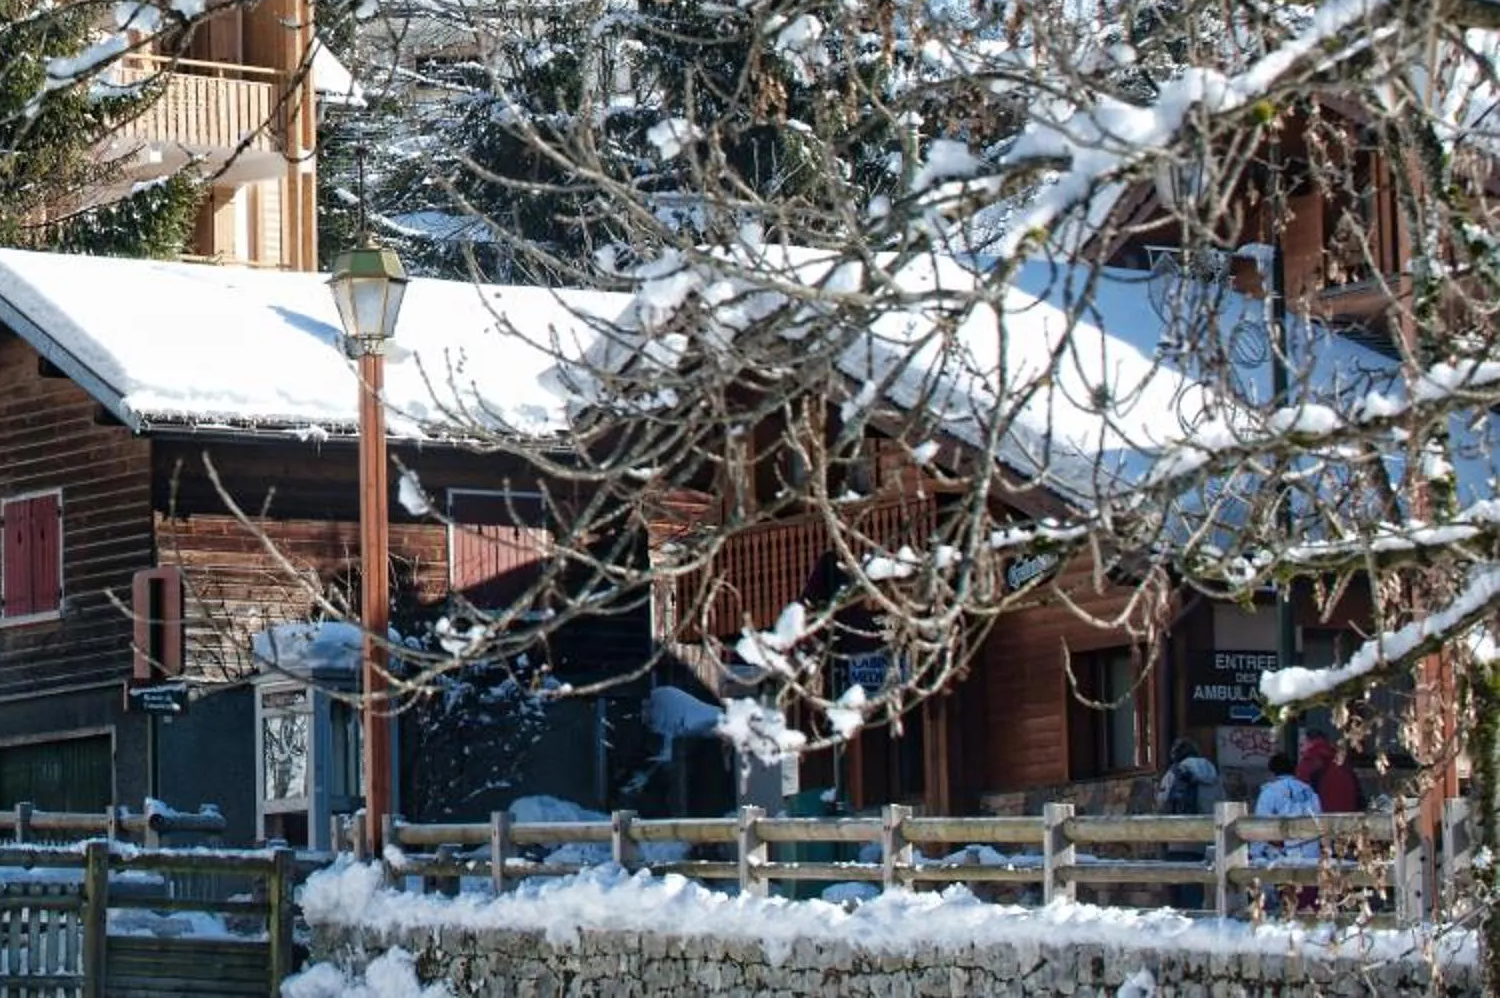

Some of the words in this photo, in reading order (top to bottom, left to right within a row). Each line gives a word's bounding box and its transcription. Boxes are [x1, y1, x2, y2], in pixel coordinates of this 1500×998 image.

[1215, 653, 1277, 671] ENTREE
[1235, 672, 1257, 683] DES
[1193, 684, 1262, 701] AMBULA
